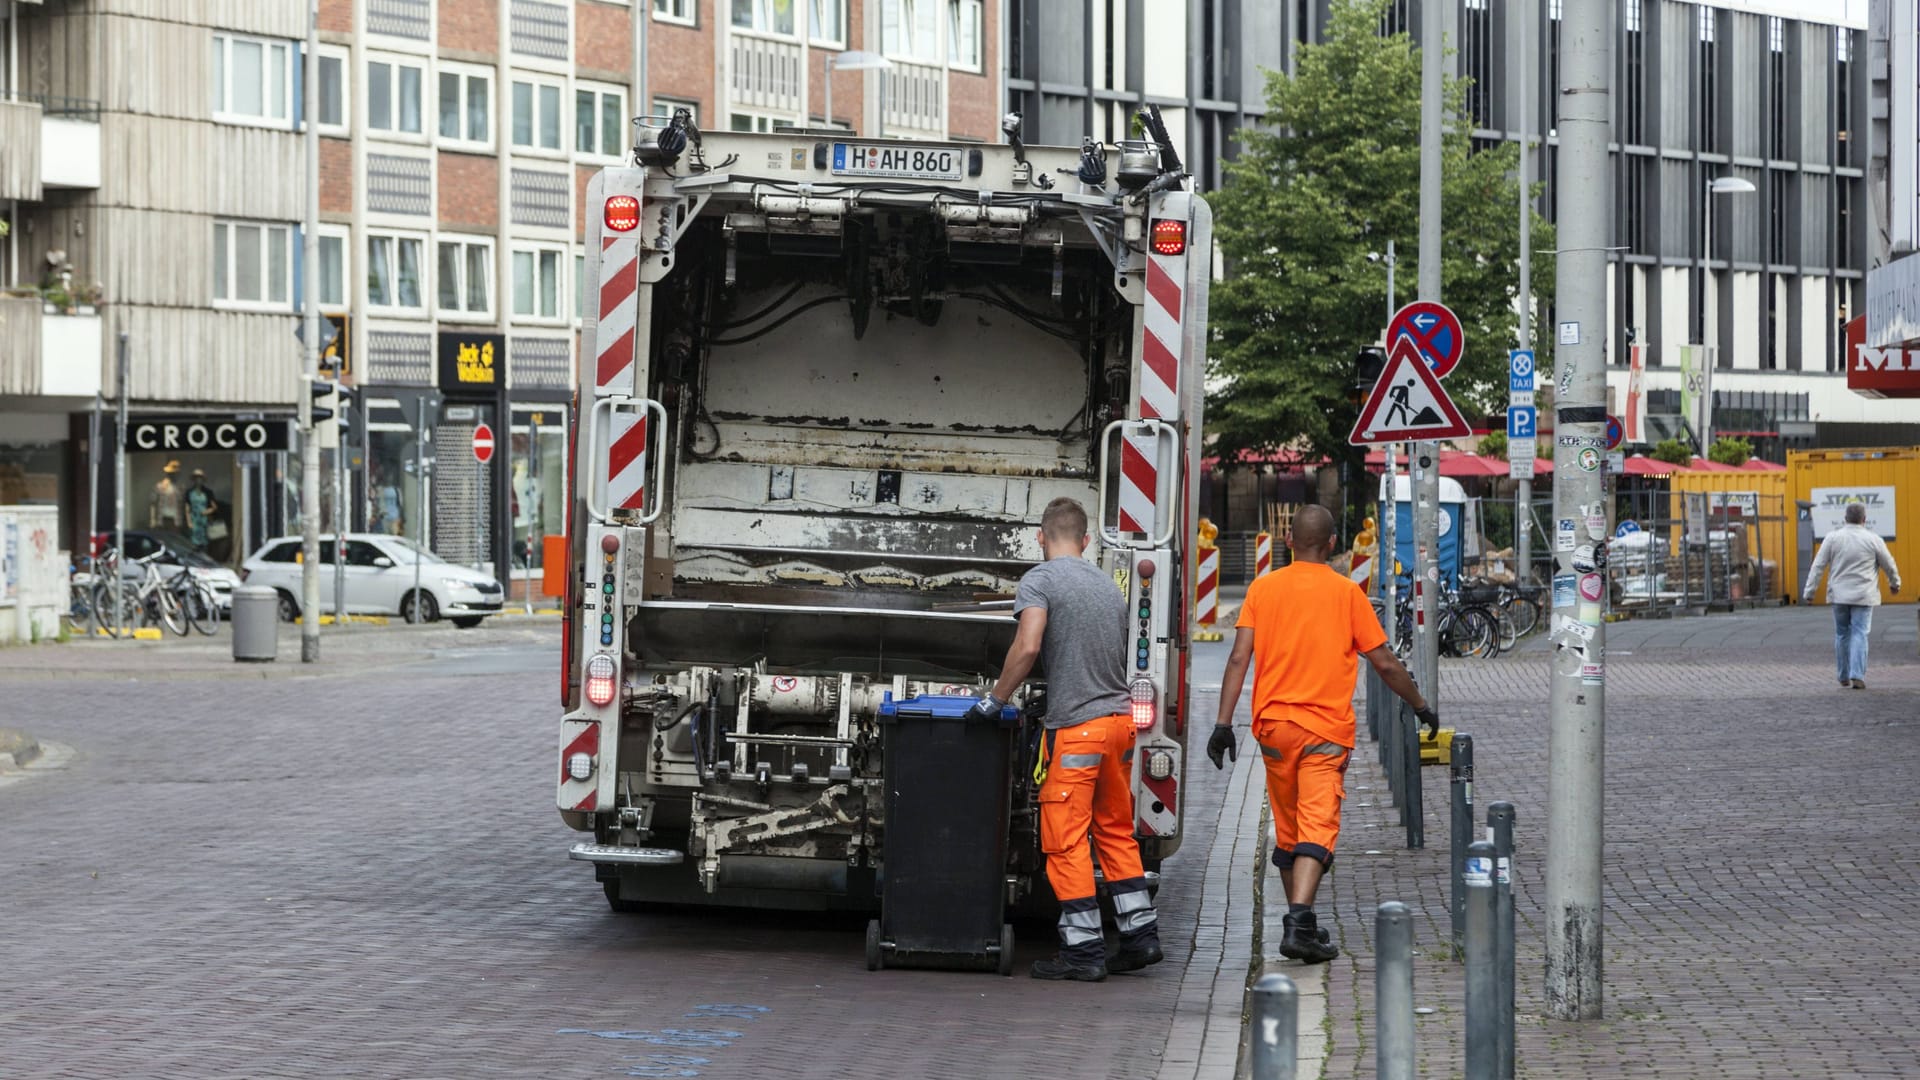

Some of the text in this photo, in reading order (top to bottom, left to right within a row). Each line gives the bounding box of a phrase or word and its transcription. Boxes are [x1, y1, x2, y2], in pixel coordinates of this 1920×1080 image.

[852, 148, 951, 172] H AH 860
[1513, 379, 1531, 387] TAXI
[1514, 410, 1530, 436] P
[136, 424, 267, 449] CROCO
